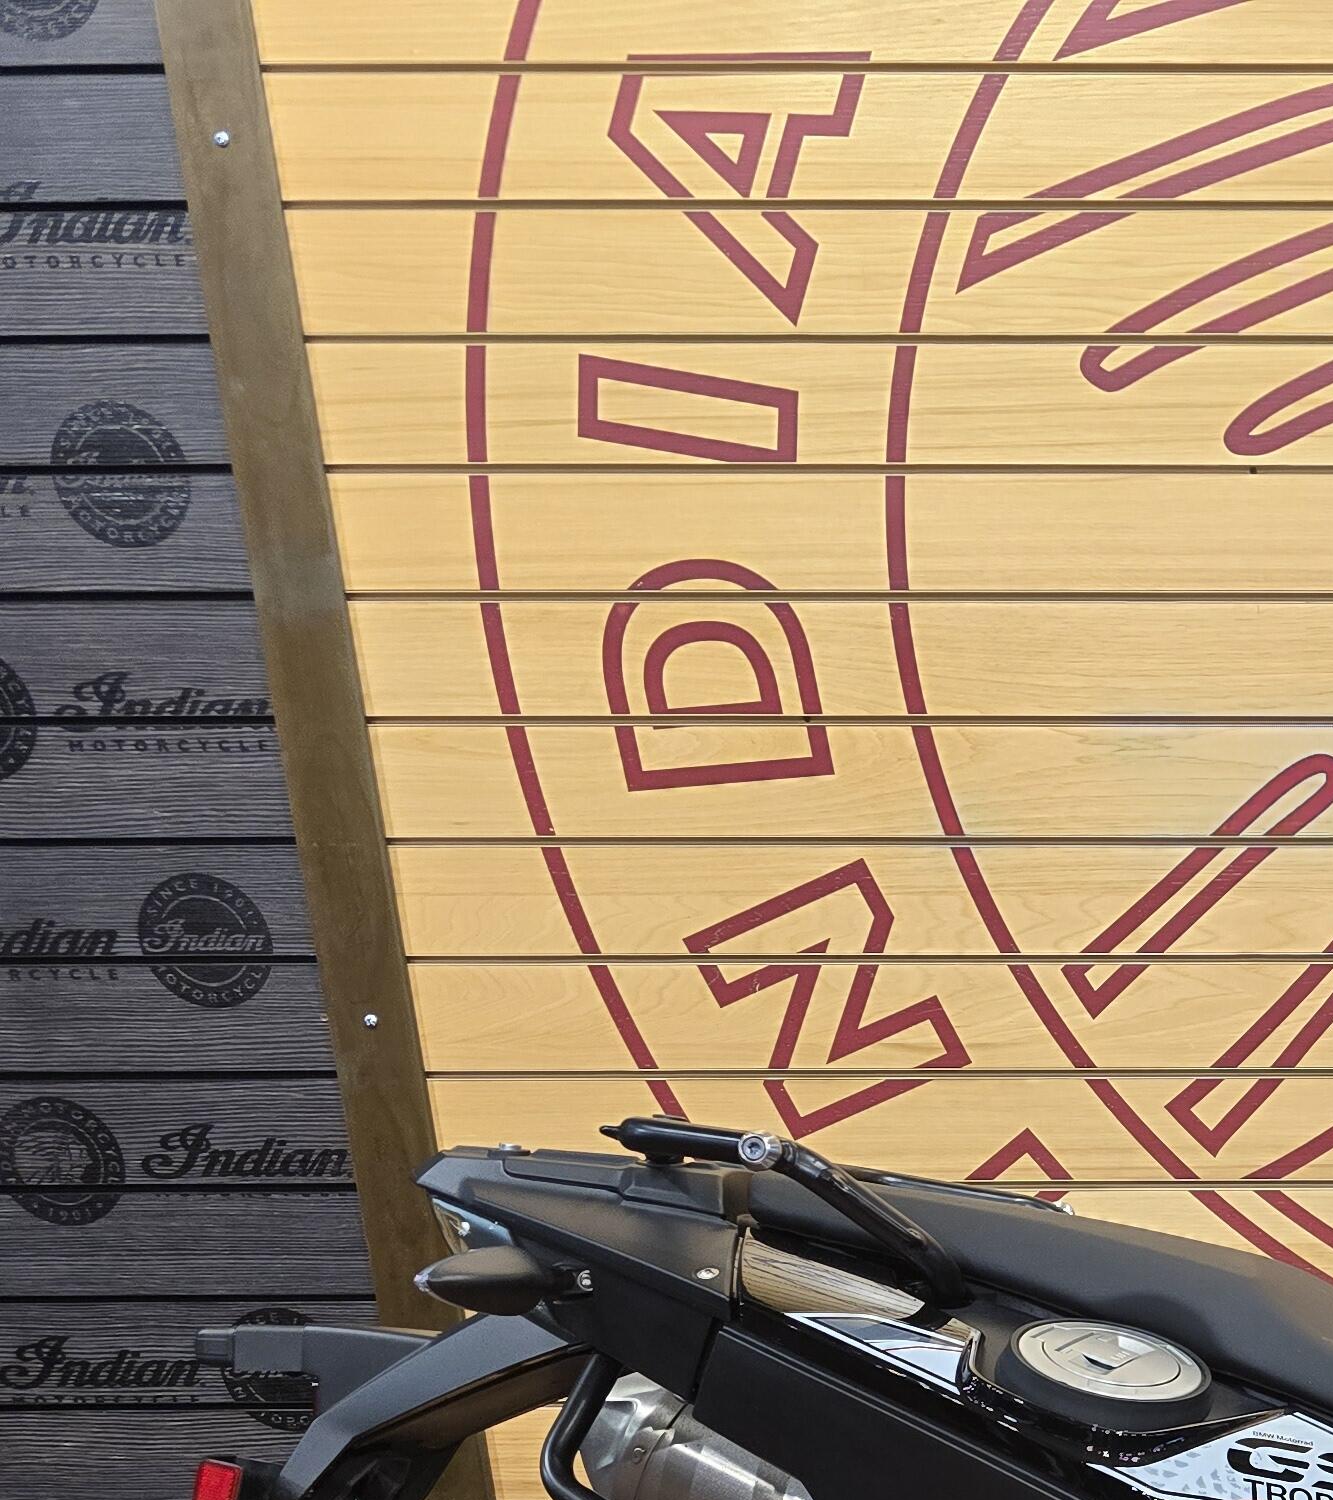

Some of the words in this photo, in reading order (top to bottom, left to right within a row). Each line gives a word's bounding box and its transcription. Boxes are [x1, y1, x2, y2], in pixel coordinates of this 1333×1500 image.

[0, 254, 187, 269] OTORCYCLE
[68, 739, 272, 753] MOTORCYCLE
[0, 918, 119, 956] dian
[143, 918, 267, 953] Indian
[8, 968, 120, 981] RCYCLE
[141, 1123, 350, 1179] Indian
[0, 1335, 201, 1389] Indian
[1252, 1430, 1275, 1439] BMW
[1276, 1434, 1314, 1446] Motorrad
